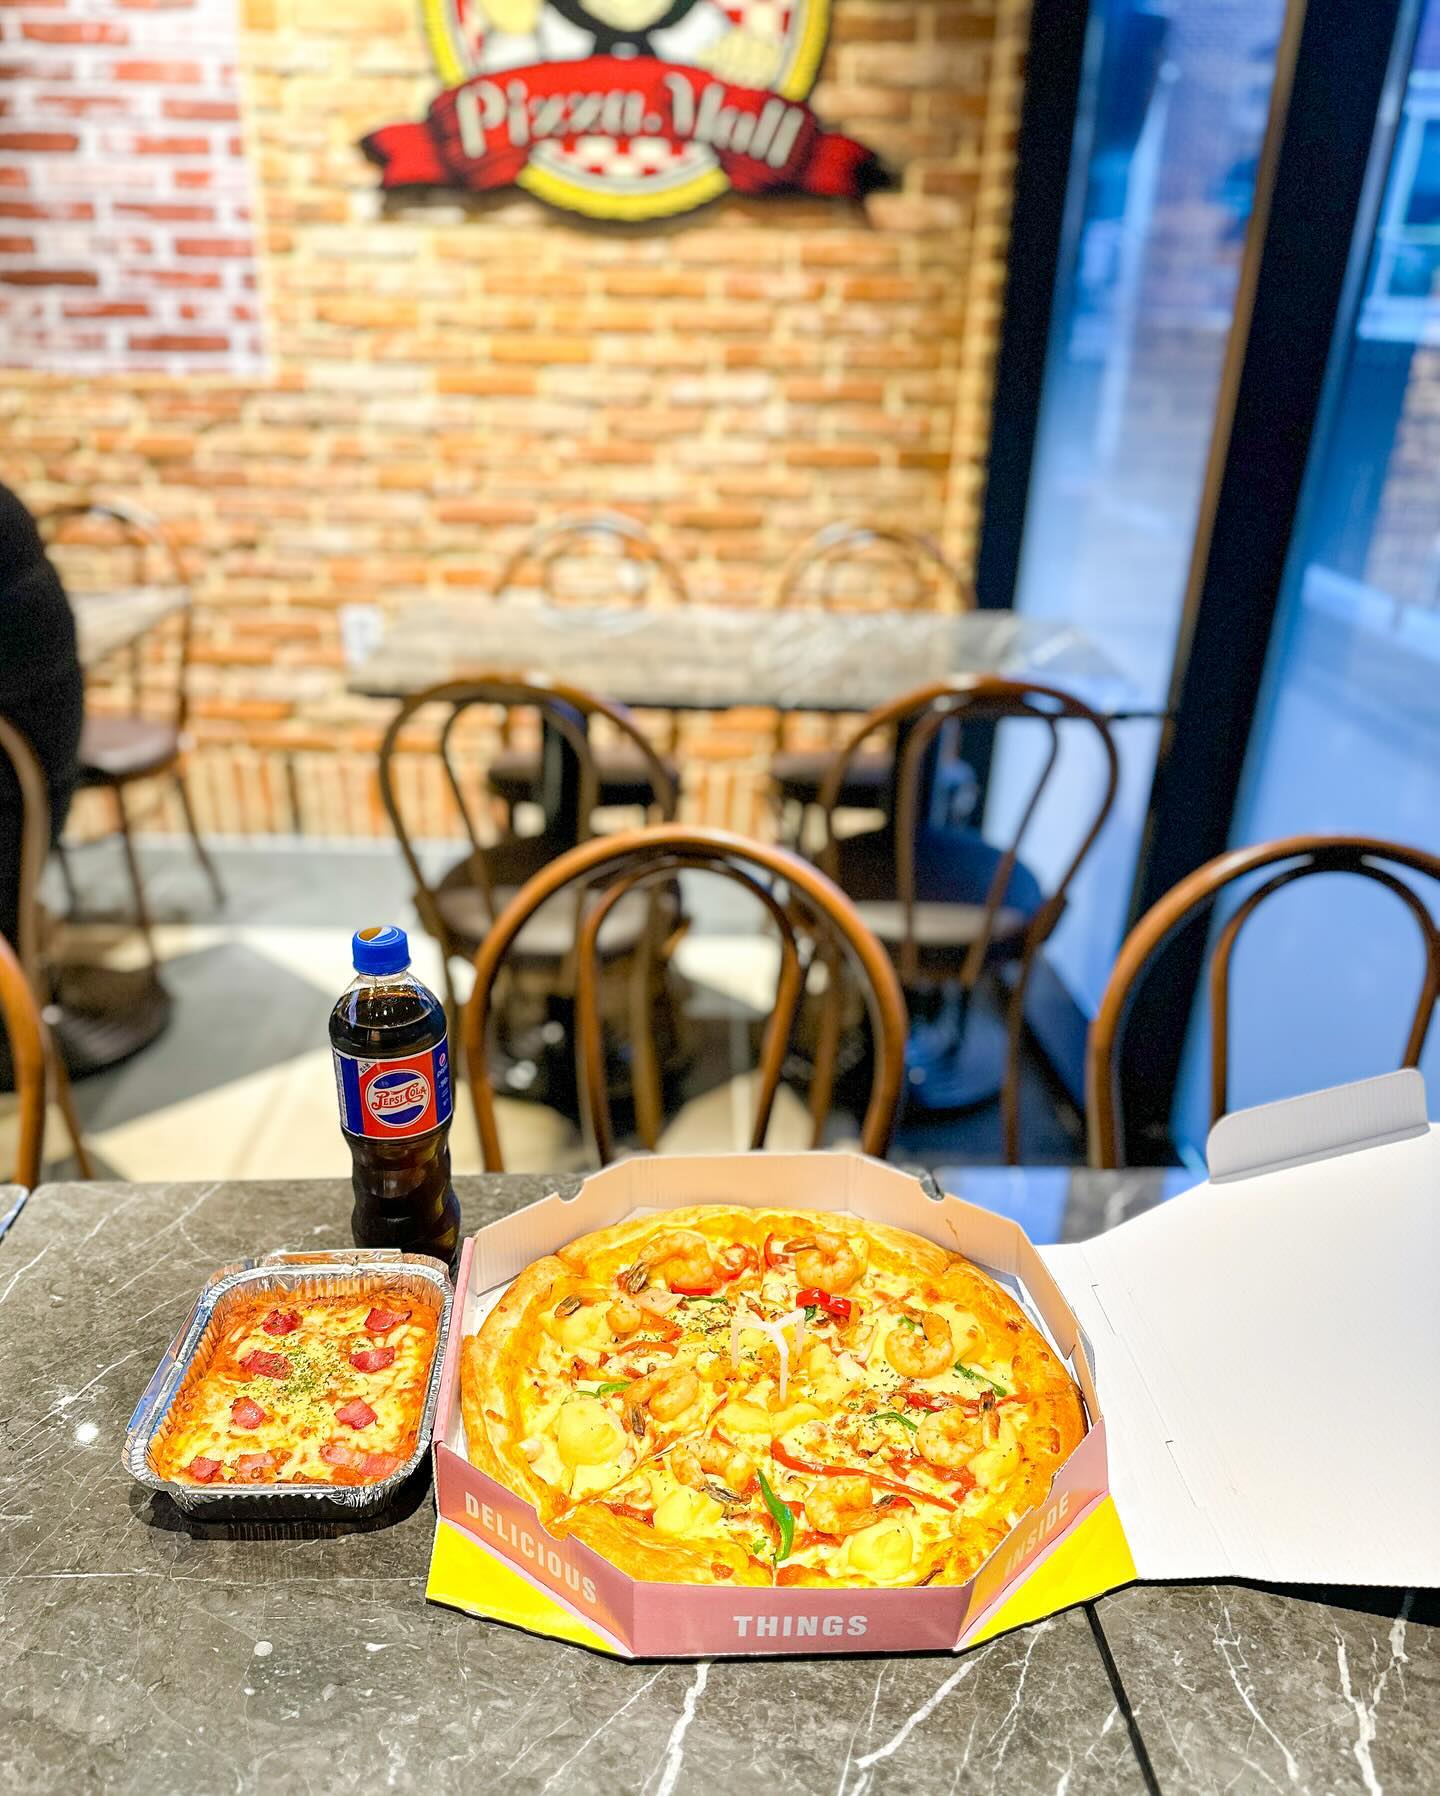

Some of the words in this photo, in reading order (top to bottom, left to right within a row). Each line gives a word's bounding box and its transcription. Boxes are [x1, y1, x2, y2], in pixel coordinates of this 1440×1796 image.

[464, 1491, 597, 1604] DELICIOUS
[1004, 1490, 1070, 1577] INSIDE
[732, 1615, 868, 1637] THINGS
